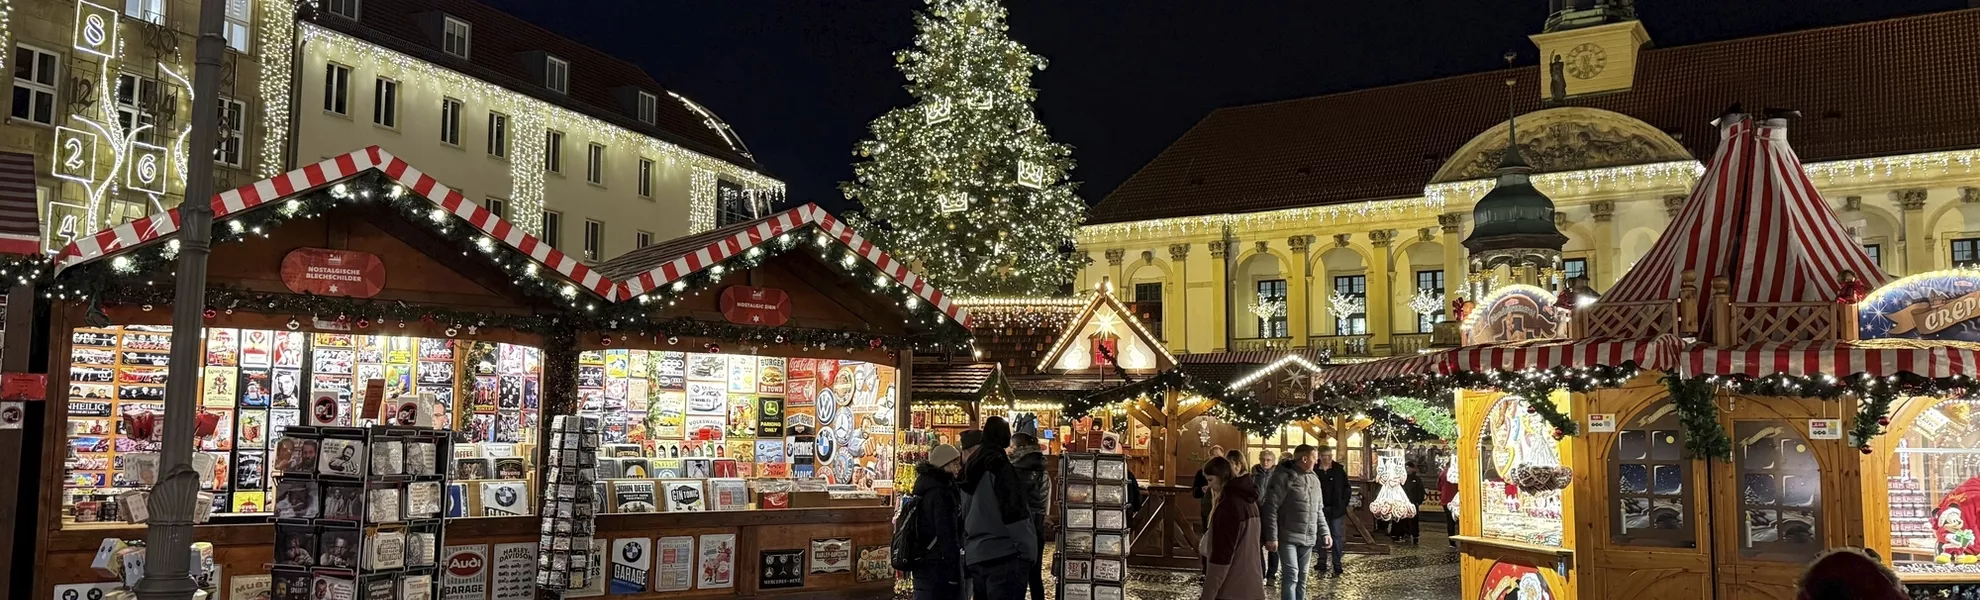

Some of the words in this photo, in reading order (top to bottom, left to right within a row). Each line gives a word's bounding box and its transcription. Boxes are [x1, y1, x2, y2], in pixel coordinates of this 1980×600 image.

[84, 14, 105, 46] 8
[65, 138, 84, 169] 2
[138, 154, 156, 184] 6
[58, 215, 77, 246] 4
[307, 266, 360, 275] NOSTALGISCHE
[306, 272, 362, 282] BLECHSCHILDER
[761, 358, 784, 367] BURGER
[794, 441, 814, 456] SERVICE
[616, 484, 634, 493] JOHN
[634, 484, 652, 493] DEERE
[672, 489, 684, 501] GIN
[683, 490, 699, 499] TONIC
[449, 558, 482, 570] Audi
[499, 553, 534, 563] DAVIDSON
[868, 560, 887, 570] BAR
[614, 564, 646, 586] GARAGE
[445, 584, 484, 596] GARAGE
